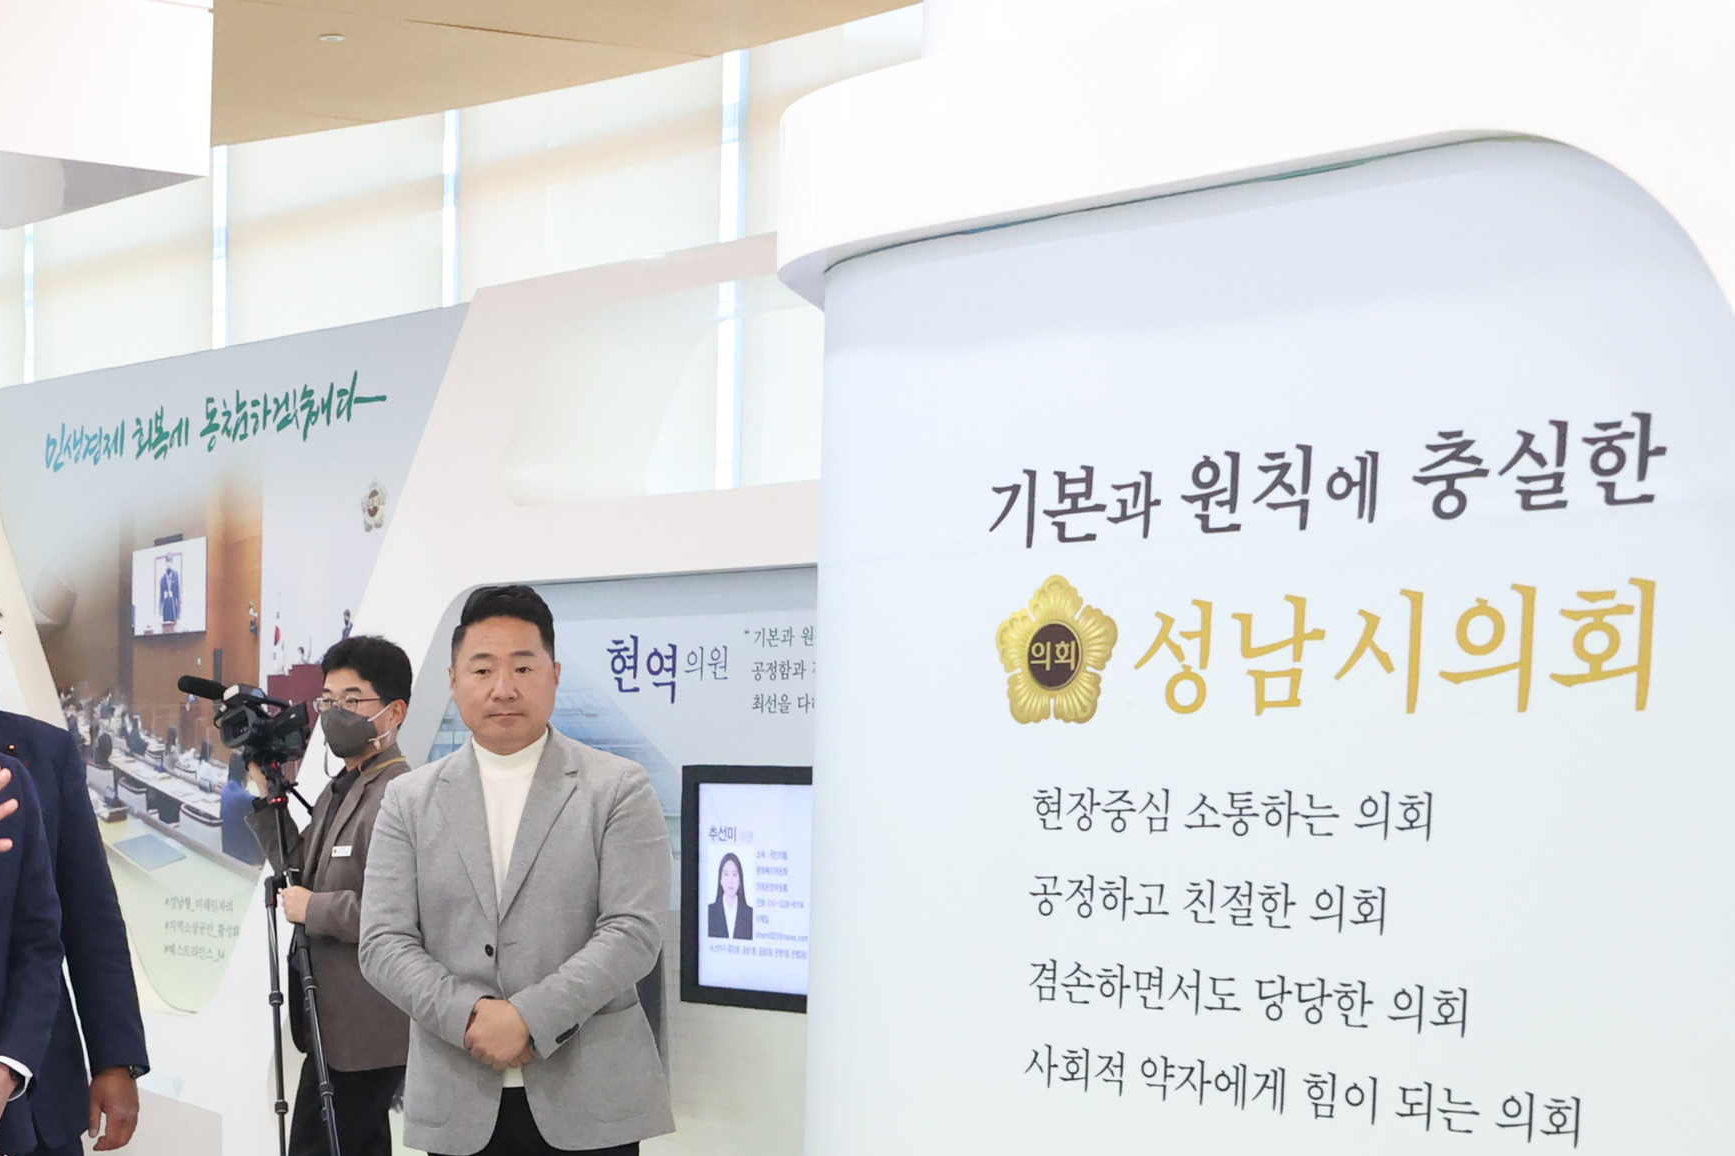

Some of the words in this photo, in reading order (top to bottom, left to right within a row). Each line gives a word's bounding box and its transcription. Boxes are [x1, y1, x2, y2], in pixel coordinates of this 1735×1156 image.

[989, 465, 1161, 548] 기본과
[1181, 444, 1379, 534] 원칙에
[1412, 412, 1667, 520] 충실한
[801, 626, 816, 647] 원
[1030, 640, 1076, 671] 의회
[1134, 578, 1656, 716] 성남시의회
[751, 659, 806, 681] 공정함과
[752, 693, 791, 714] 최선을
[708, 825, 737, 842] 추선미
[1033, 787, 1170, 834] 현장중심
[1184, 789, 1340, 838] 소통하는
[1354, 791, 1433, 841] 의회
[1029, 874, 1169, 922] 공정하고
[1184, 879, 1296, 930] 친절한
[1310, 884, 1387, 936] 의회
[1030, 959, 1242, 1016] 겸손하면서도
[1255, 975, 1374, 1028] 당당한
[1388, 984, 1468, 1039] 의회
[1025, 1044, 1125, 1097] 사회적
[1141, 1055, 1286, 1115] 약자에게
[1303, 1072, 1378, 1126] 힘이
[1395, 1081, 1481, 1134] 되는
[1496, 1091, 1581, 1149] 의회
